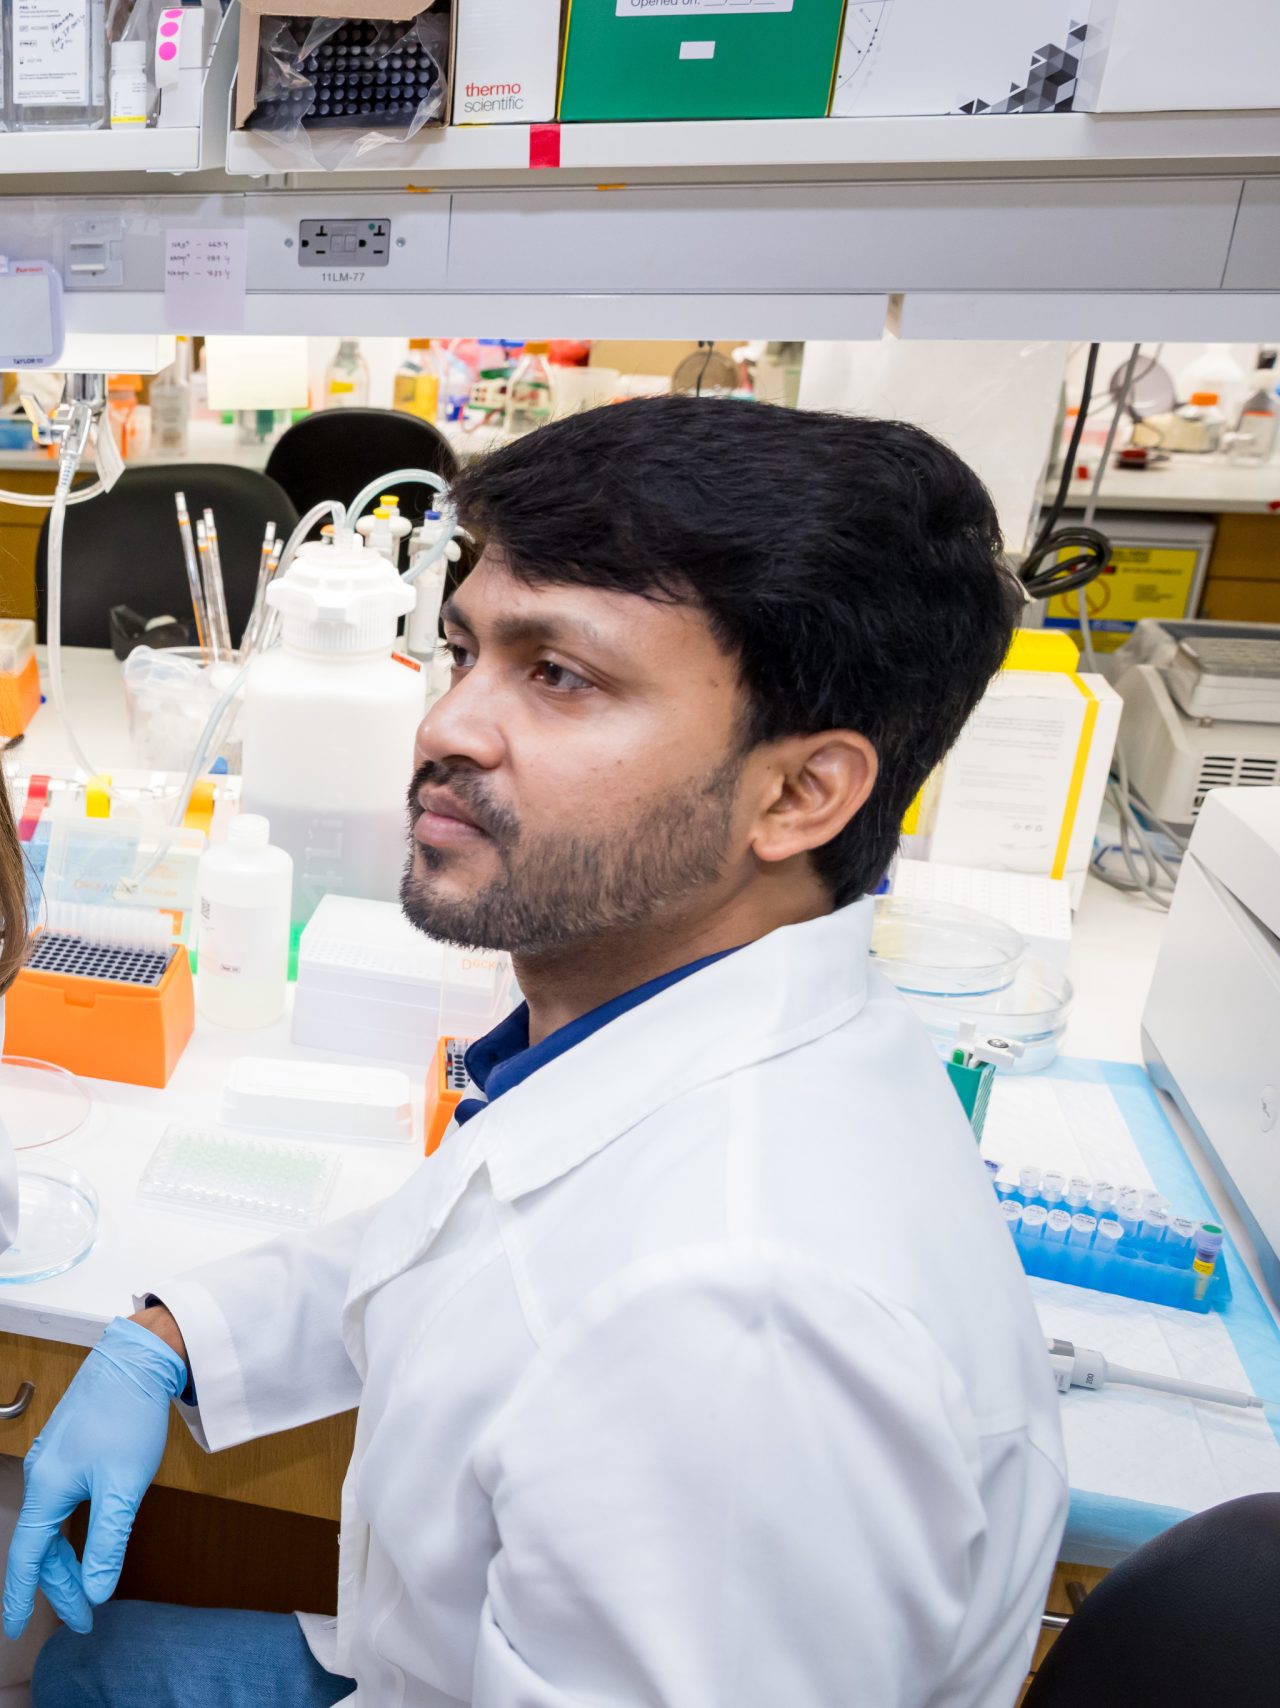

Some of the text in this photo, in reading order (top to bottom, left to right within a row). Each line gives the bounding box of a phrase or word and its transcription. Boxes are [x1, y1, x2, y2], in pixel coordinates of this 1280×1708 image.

[465, 82, 522, 98] thermo
[464, 96, 525, 113] scientific
[322, 272, 366, 282] 11LM-77
[1085, 1373, 1095, 1385] 200
